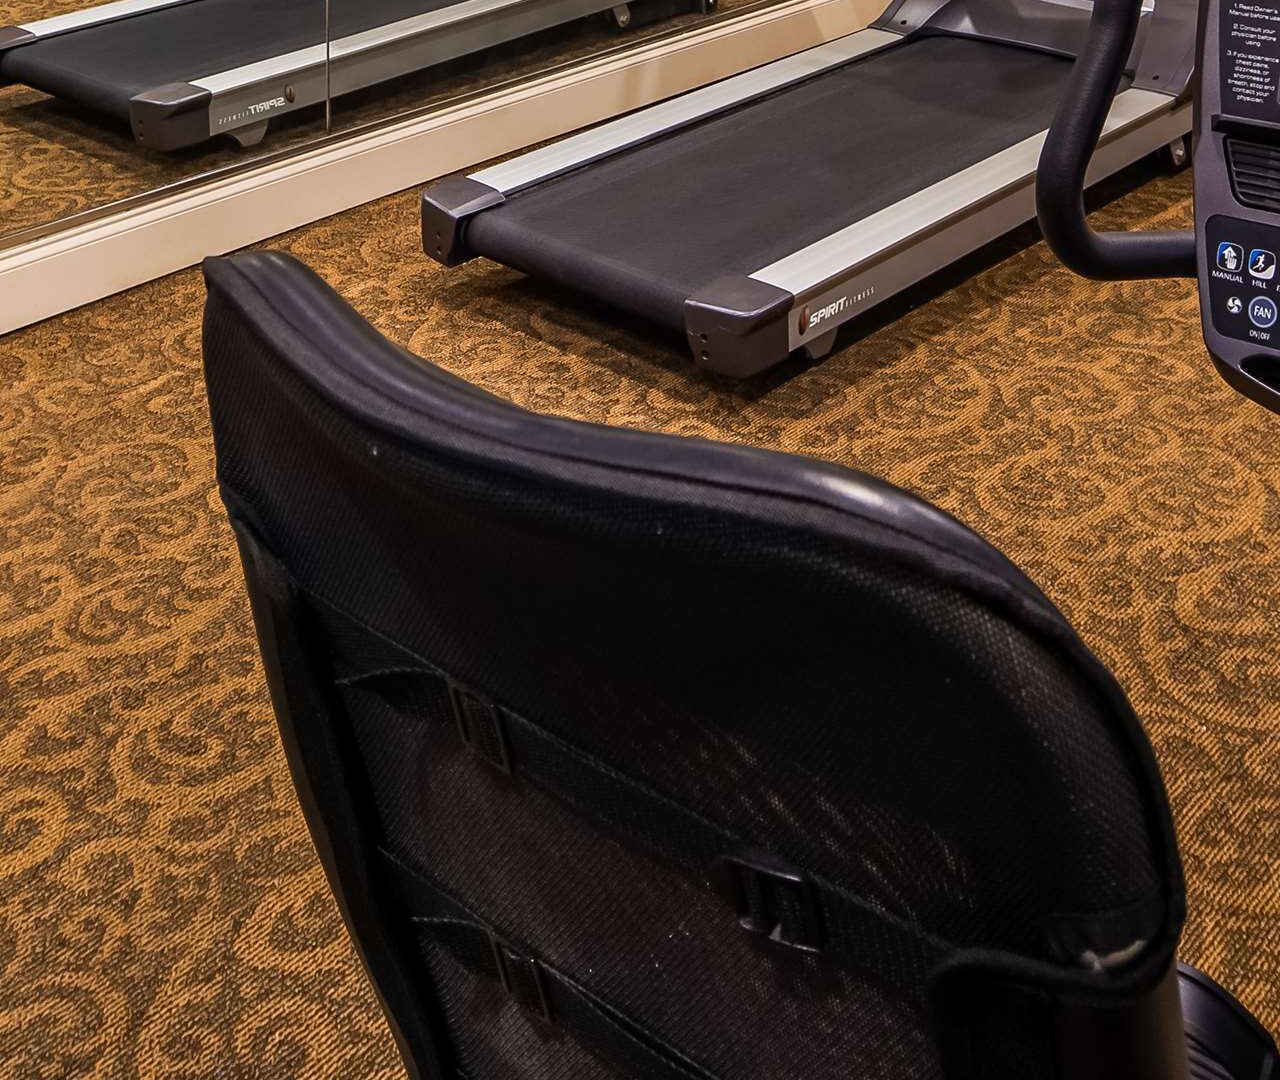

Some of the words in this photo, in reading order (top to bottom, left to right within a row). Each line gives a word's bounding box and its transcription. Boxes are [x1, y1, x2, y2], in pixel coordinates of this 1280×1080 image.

[1211, 270, 1244, 284] MANUAL
[1251, 279, 1268, 290] HILL
[809, 296, 847, 329] SPIRIT
[1253, 305, 1272, 320] FAN
